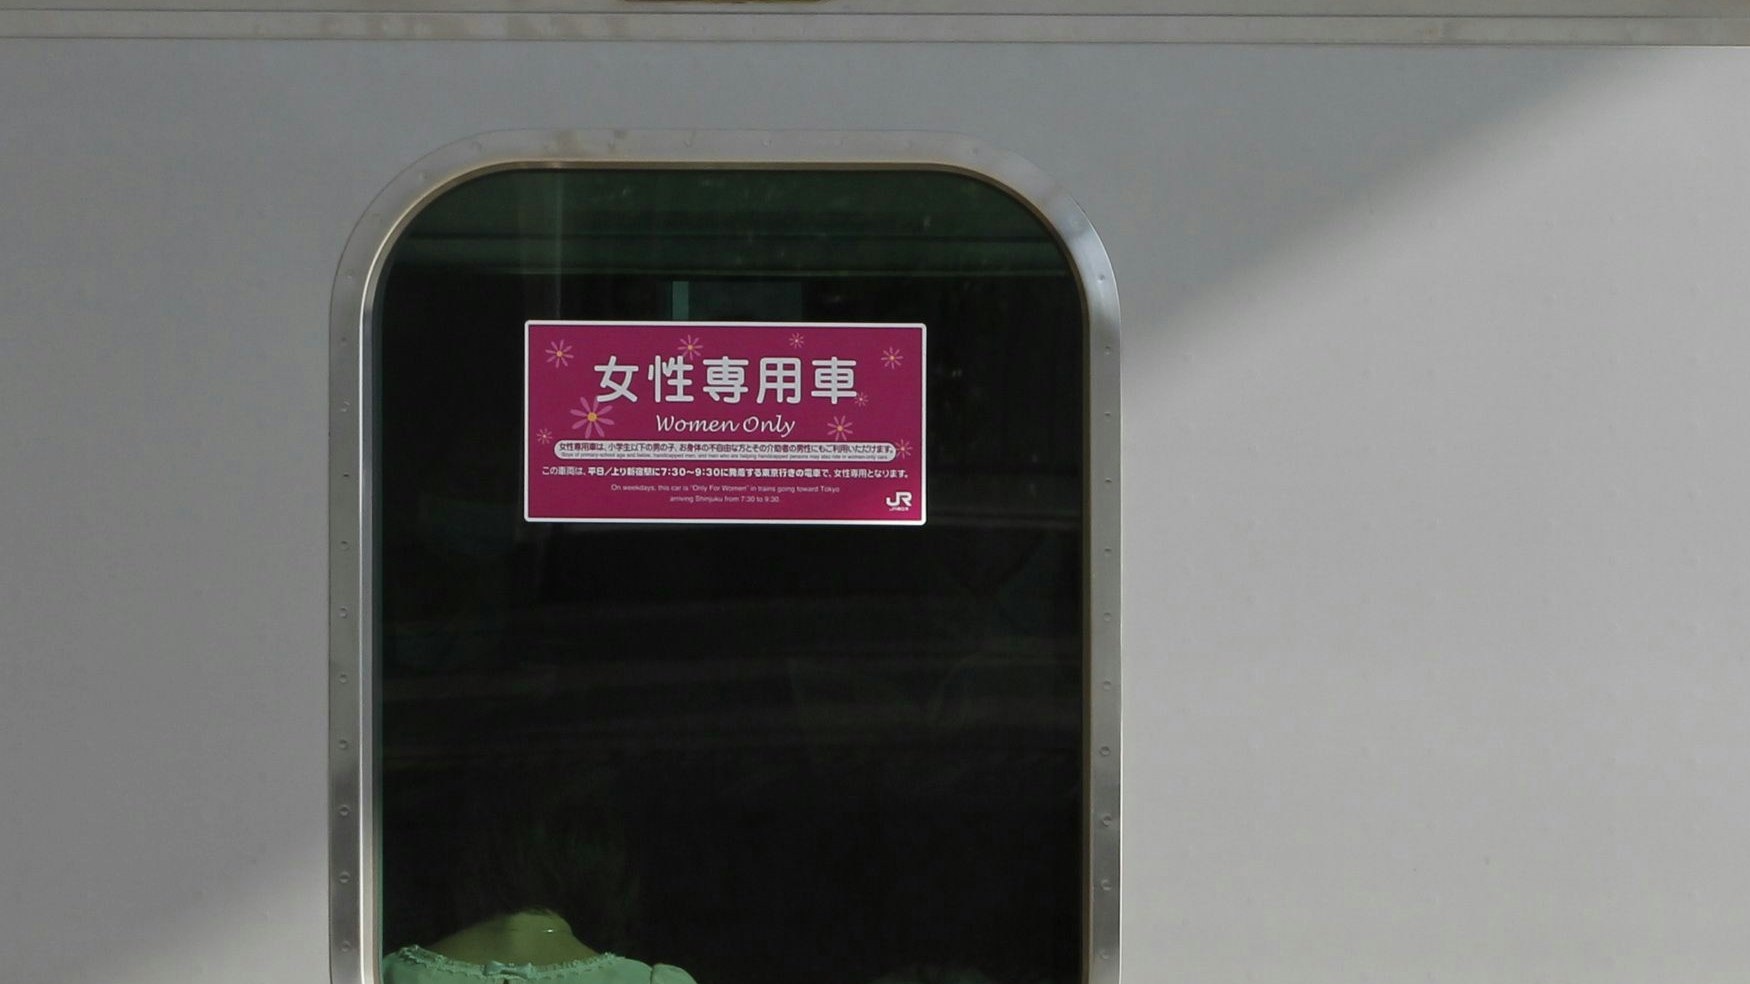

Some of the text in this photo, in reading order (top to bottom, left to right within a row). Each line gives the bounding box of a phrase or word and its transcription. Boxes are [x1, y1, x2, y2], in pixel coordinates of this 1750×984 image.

[594, 355, 858, 404] 女性専用車
[655, 414, 796, 438] Women Only
[886, 491, 912, 506] JR
